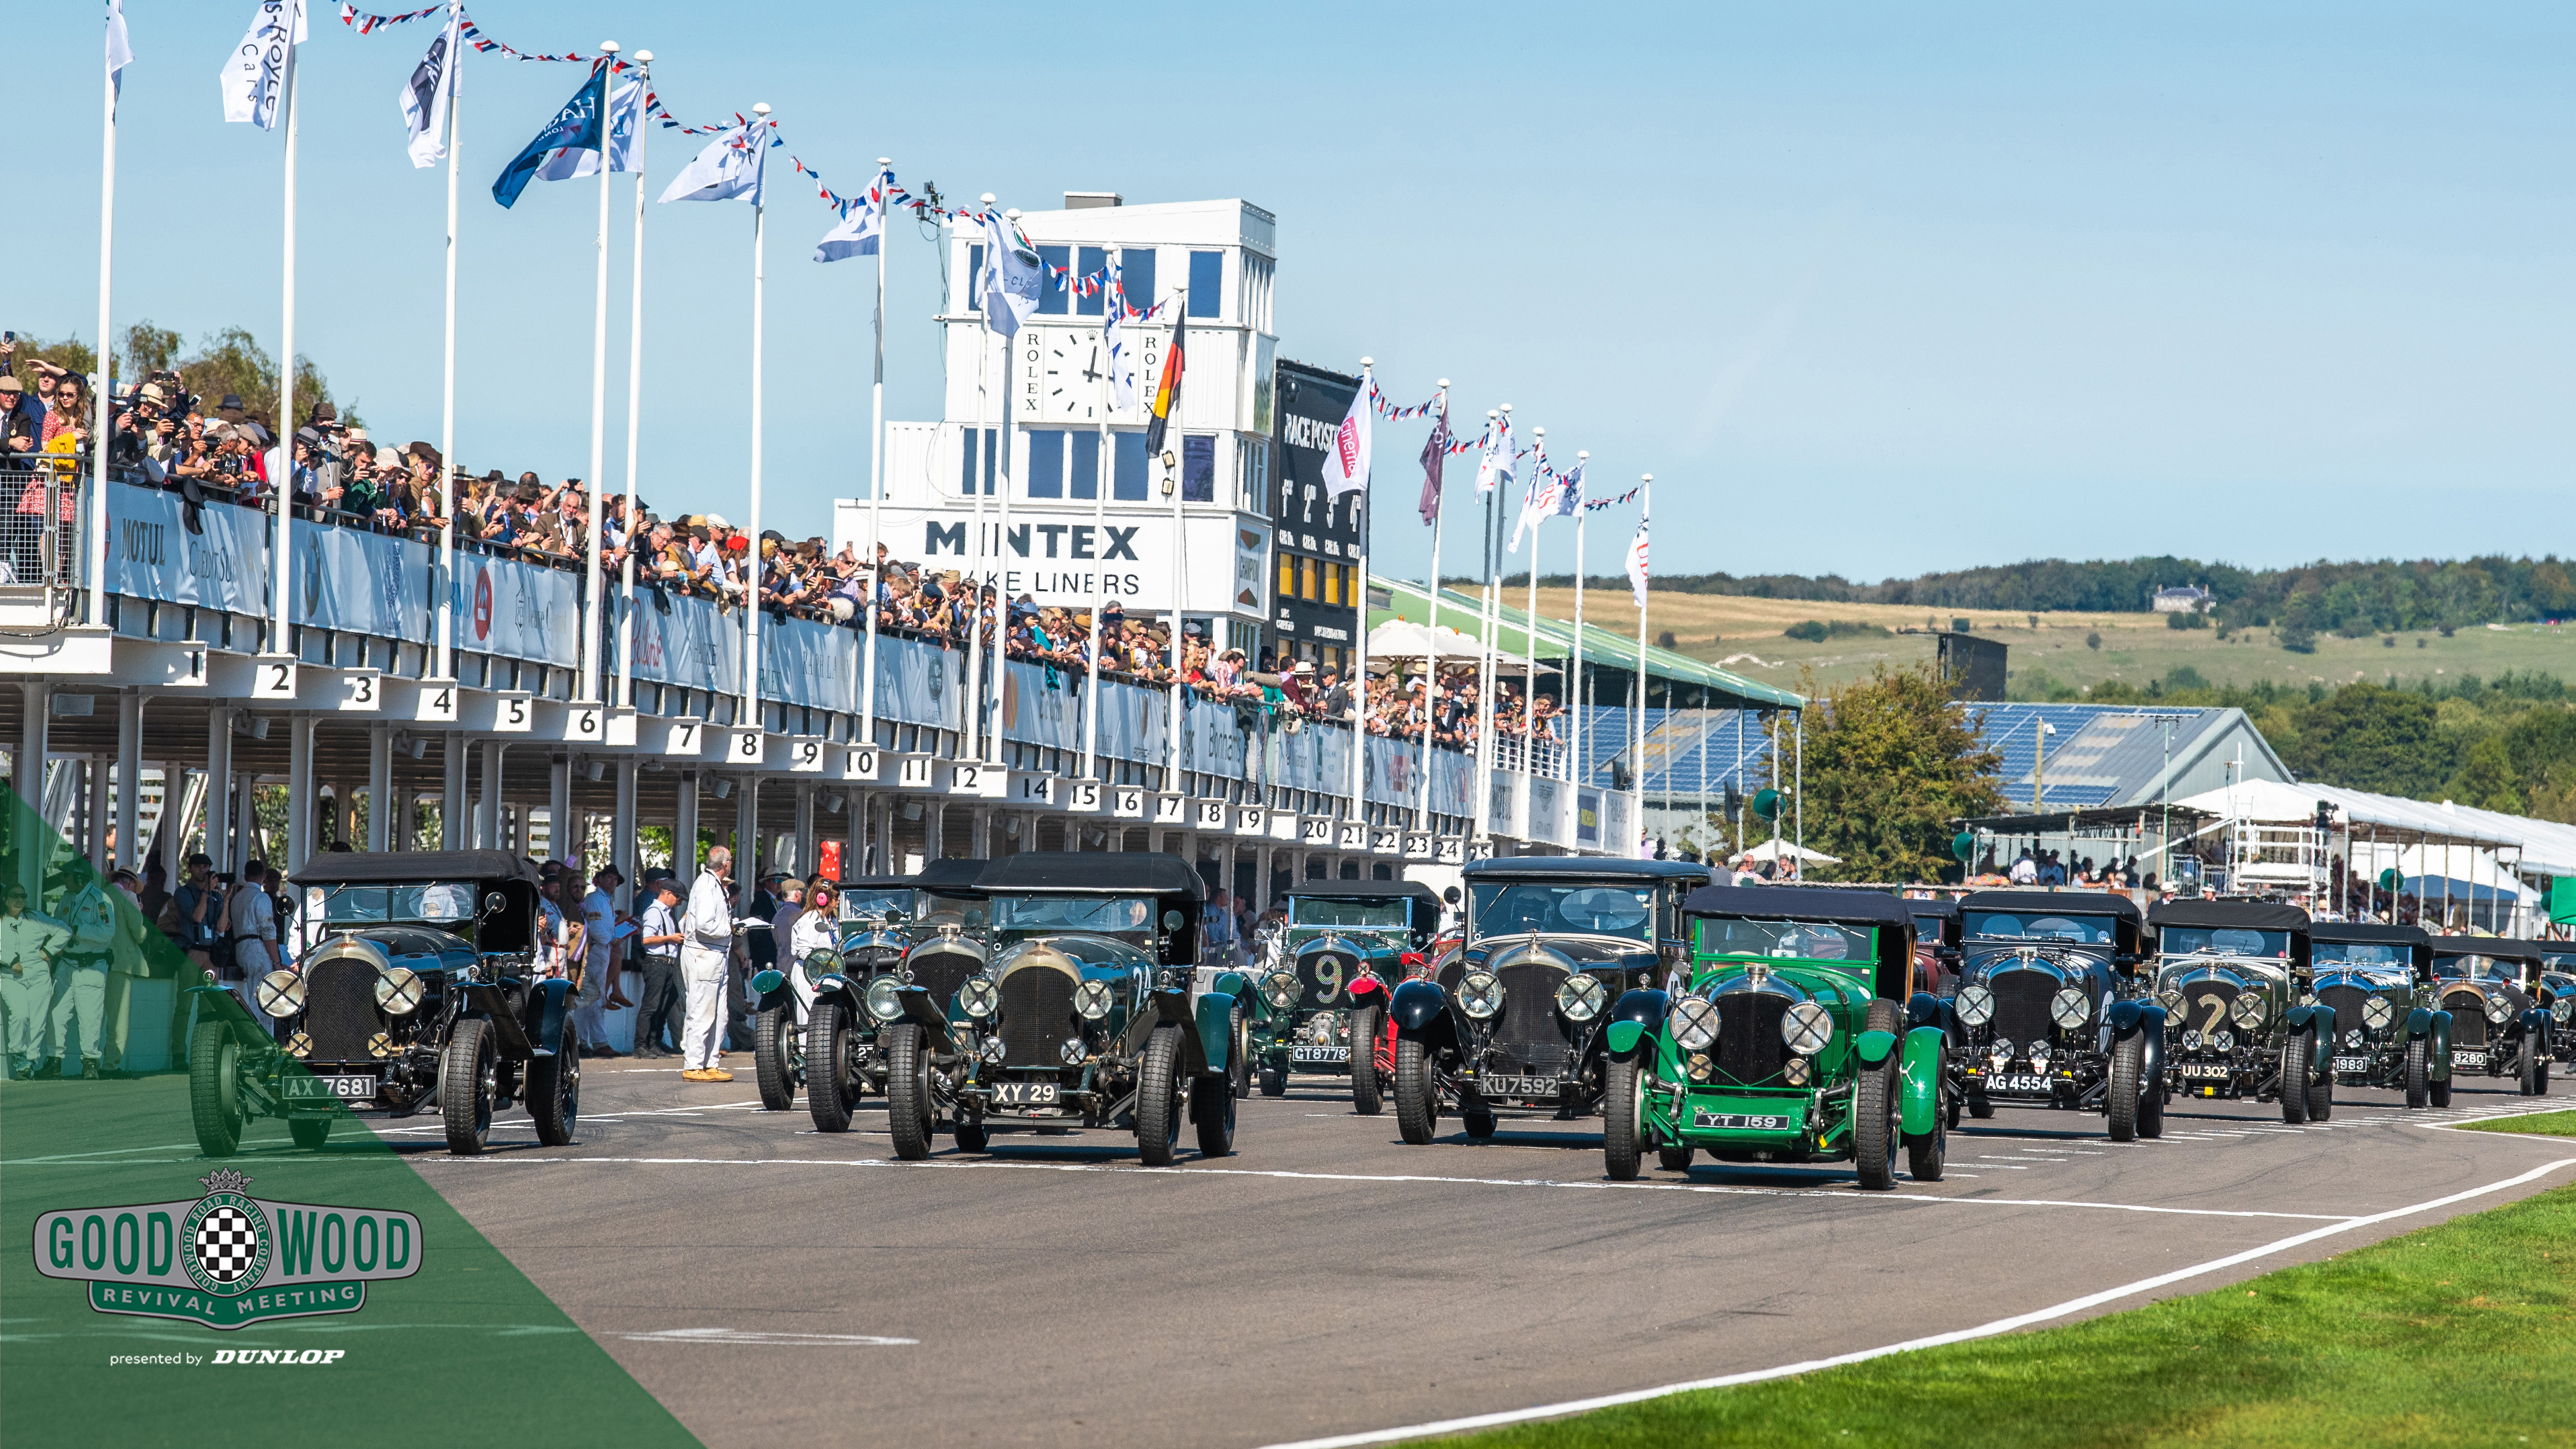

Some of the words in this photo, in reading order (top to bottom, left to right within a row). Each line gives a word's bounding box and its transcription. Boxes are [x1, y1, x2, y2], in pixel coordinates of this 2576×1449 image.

[242, 44, 258, 102] Cars
[1026, 334, 1040, 410] ROLEX
[1144, 337, 1157, 413] ROLEX
[1284, 413, 1311, 448] RACE
[1311, 419, 1341, 453] POSIT
[121, 518, 165, 566] MOTUL
[925, 521, 1140, 561] MNTEX
[1035, 572, 1139, 595] LINERS
[192, 651, 198, 677] 1
[803, 651, 824, 677] RAPH
[271, 664, 288, 690] 2
[758, 668, 781, 695] RLEX
[356, 676, 371, 702] 3
[434, 689, 451, 713] 4
[510, 699, 524, 723] 5
[580, 709, 595, 733] 6
[680, 724, 695, 747] 7
[742, 733, 756, 756] 8
[1209, 722, 1241, 763] Bonhams
[804, 742, 818, 764] 9
[846, 752, 872, 773] 10
[906, 759, 926, 780] 11
[952, 767, 977, 788] 12
[1024, 778, 1048, 798] 14
[1073, 785, 1095, 805] 15
[1115, 792, 1137, 811] 16
[1157, 797, 1179, 816] 17
[1198, 803, 1220, 822] 18
[1238, 810, 1260, 828] 19
[1302, 821, 1327, 838] 20
[1341, 826, 1362, 844] 21
[1372, 831, 1395, 848] 22
[1406, 837, 1428, 853] 23
[1435, 841, 1457, 858] 24
[1314, 955, 1342, 1004] 9
[2198, 993, 2226, 1045] 2
[1295, 1048, 1347, 1060] GT8779
[2336, 1059, 2364, 1070] 1983
[2454, 1053, 2484, 1064] 8280
[2183, 1065, 2201, 1077] UU
[2202, 1066, 2228, 1078] 302
[288, 1079, 314, 1096] AX
[323, 1079, 370, 1095] 7681
[994, 1085, 1023, 1102] XY
[1029, 1085, 1054, 1102] 29
[1482, 1077, 1558, 1095] KU7592
[1986, 1075, 2007, 1090] AG
[2008, 1076, 2052, 1091] 4554
[1707, 1115, 1734, 1127] YT
[1742, 1115, 1777, 1127] 159
